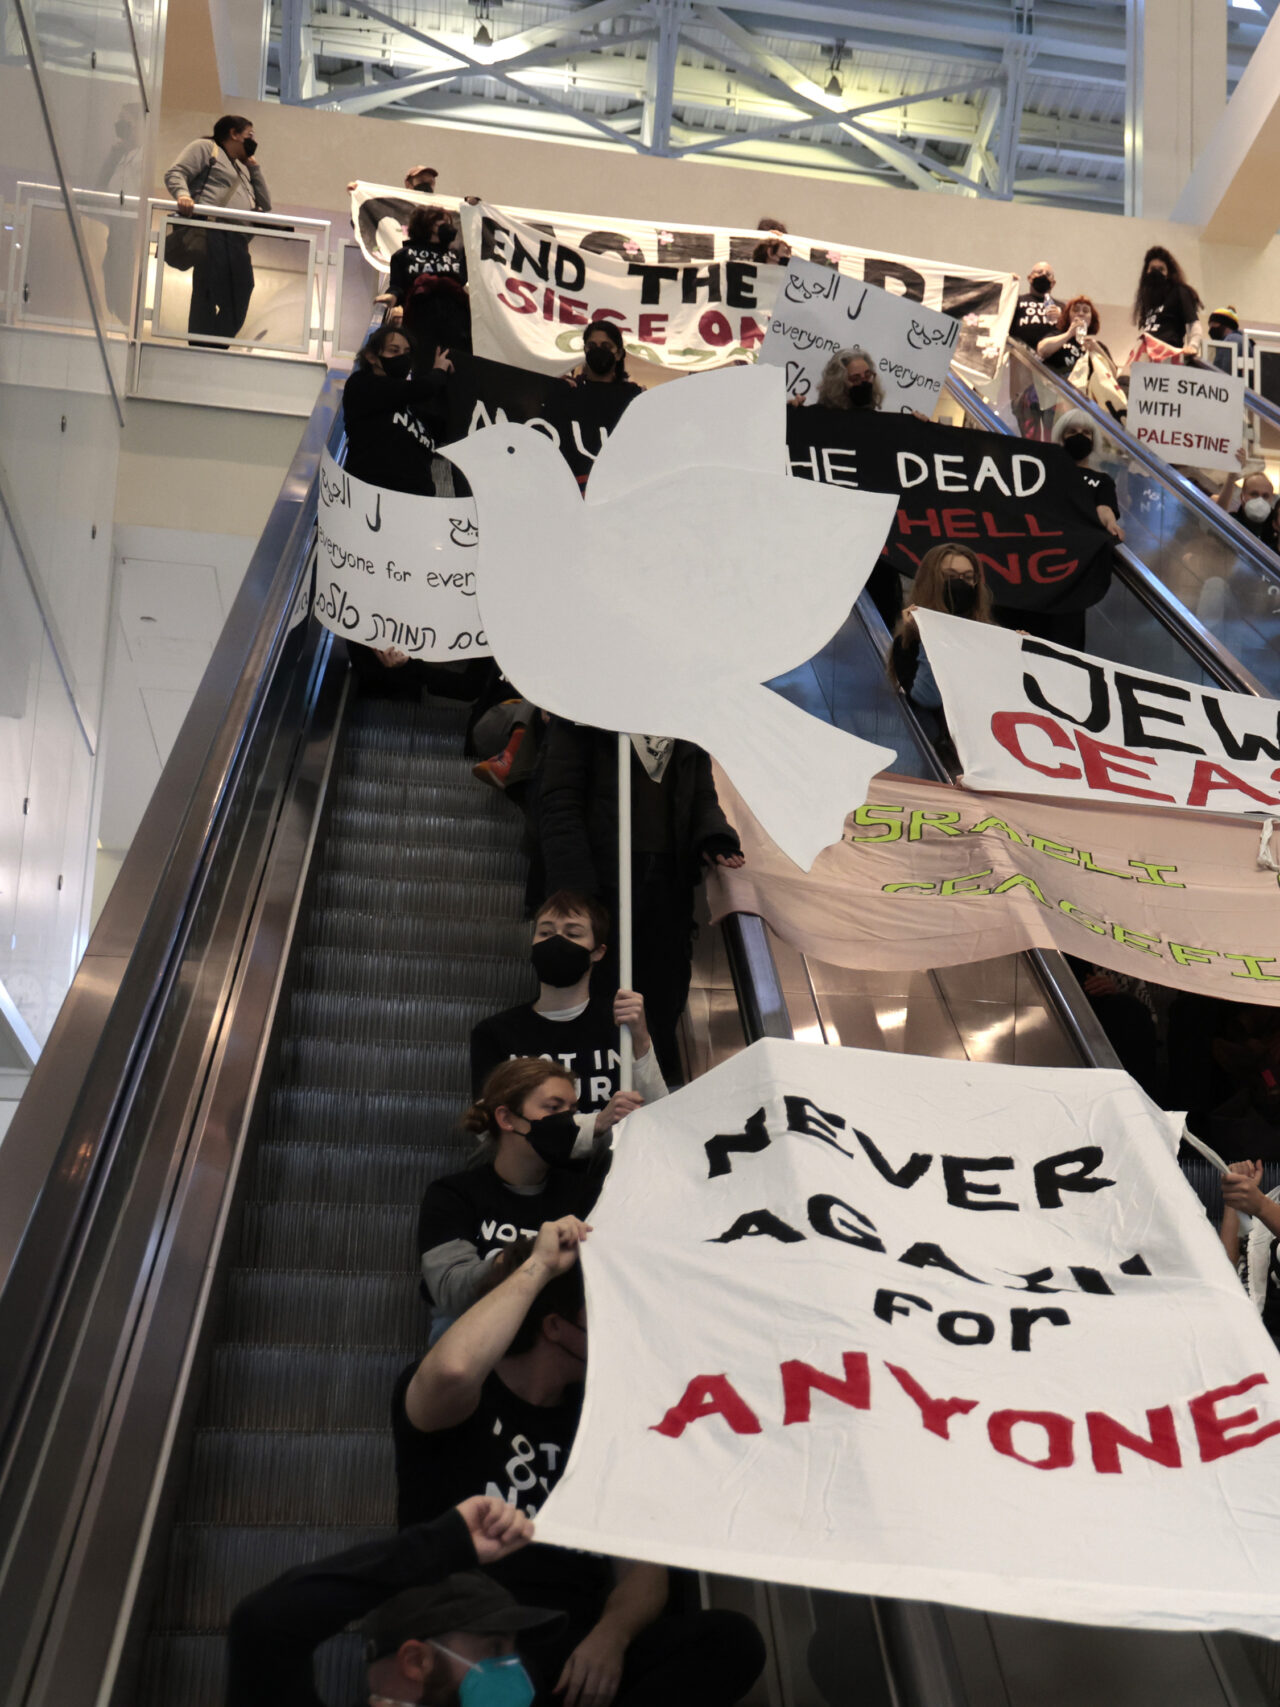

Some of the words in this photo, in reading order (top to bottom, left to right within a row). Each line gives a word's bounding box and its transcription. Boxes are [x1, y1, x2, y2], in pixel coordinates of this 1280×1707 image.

[408, 263, 460, 274] NAME
[481, 216, 586, 292] END
[627, 259, 758, 309] THE
[497, 276, 669, 345] SIEGE
[1019, 301, 1045, 309] NOT
[1025, 307, 1048, 316] OU
[771, 319, 841, 351] everyone
[879, 357, 942, 393] everyone
[1143, 376, 1170, 393] WE
[1177, 379, 1229, 403] STAND
[1138, 399, 1182, 418] WITH
[1136, 427, 1231, 454] PALESTINE
[784, 445, 859, 488] HE
[896, 451, 1046, 498] DEAD
[895, 507, 1064, 538] HELL
[318, 526, 376, 575] everyone
[386, 561, 412, 583] for
[850, 803, 1187, 889] SRAELI
[704, 1094, 1117, 1212] NEVER
[493, 1418, 562, 1471] OT
